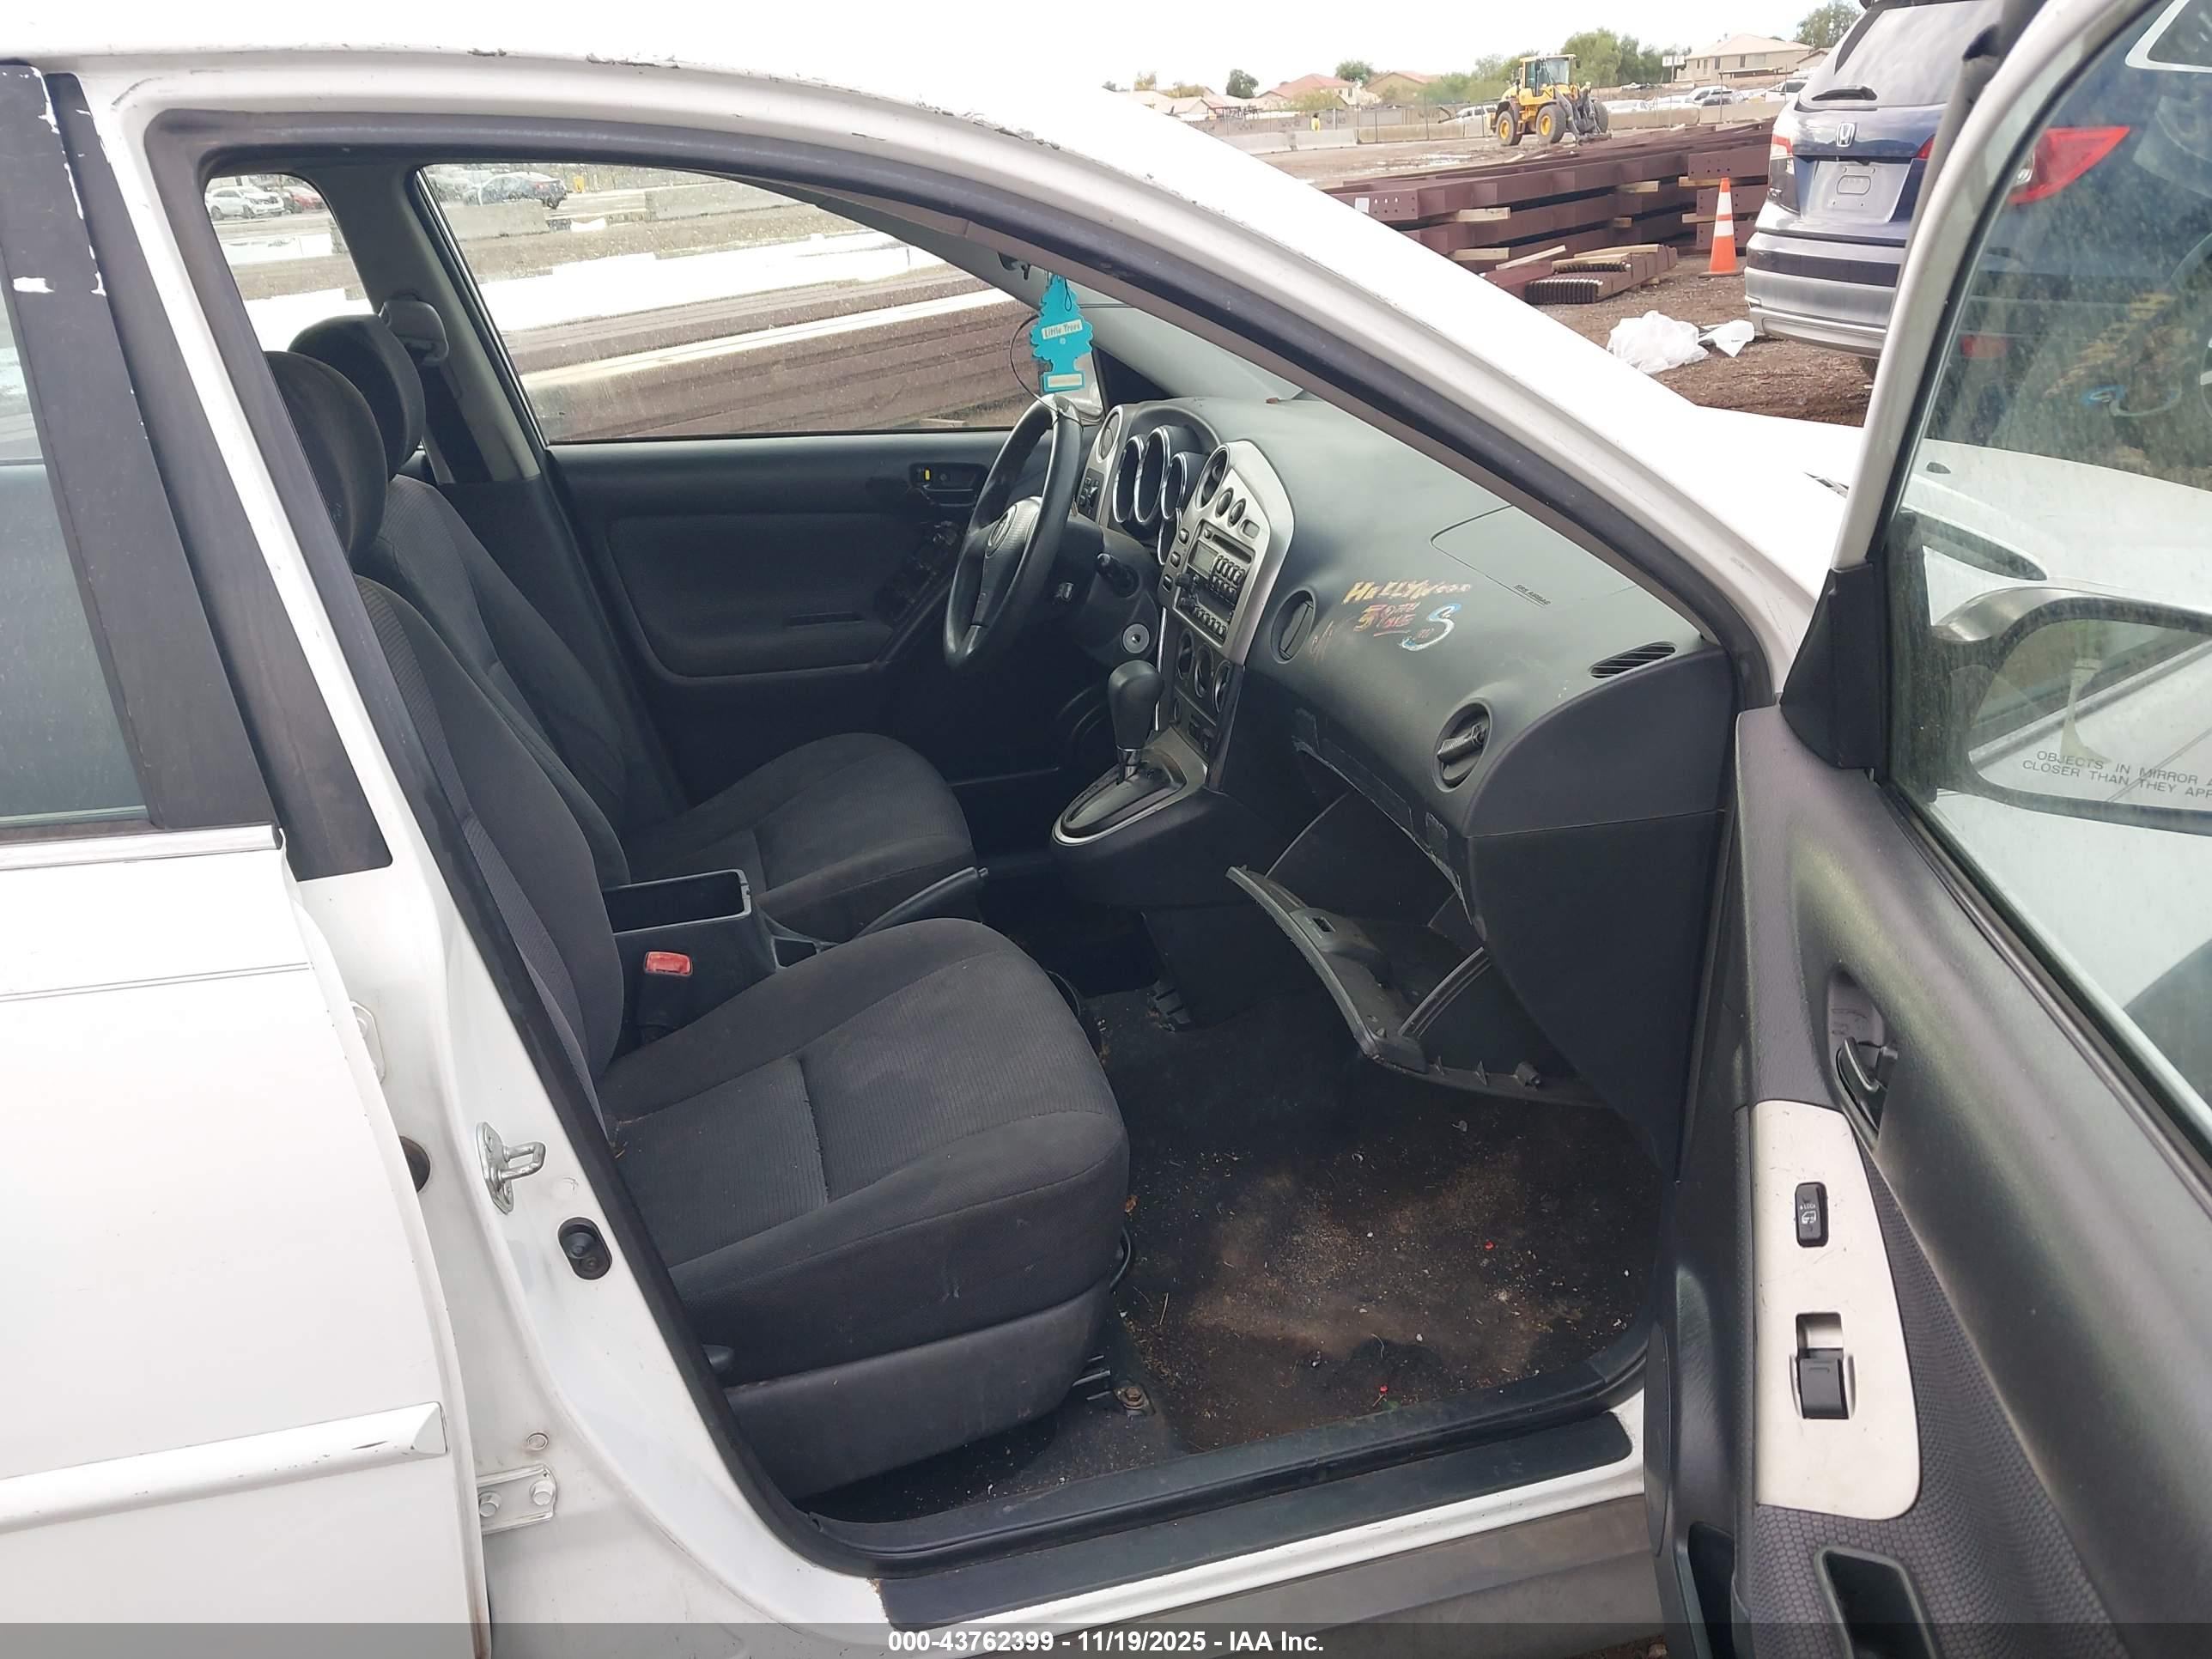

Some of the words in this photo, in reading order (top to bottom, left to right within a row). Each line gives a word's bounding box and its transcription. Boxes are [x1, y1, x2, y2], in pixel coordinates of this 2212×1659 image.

[2022, 760, 2081, 777] CLOSER
[2088, 770, 2130, 786] THAN
[2138, 778, 2178, 793] THEY
[2036, 750, 2104, 770] OBJECTS
[2115, 763, 2131, 773] IN
[2138, 767, 2198, 785] MIRROR
